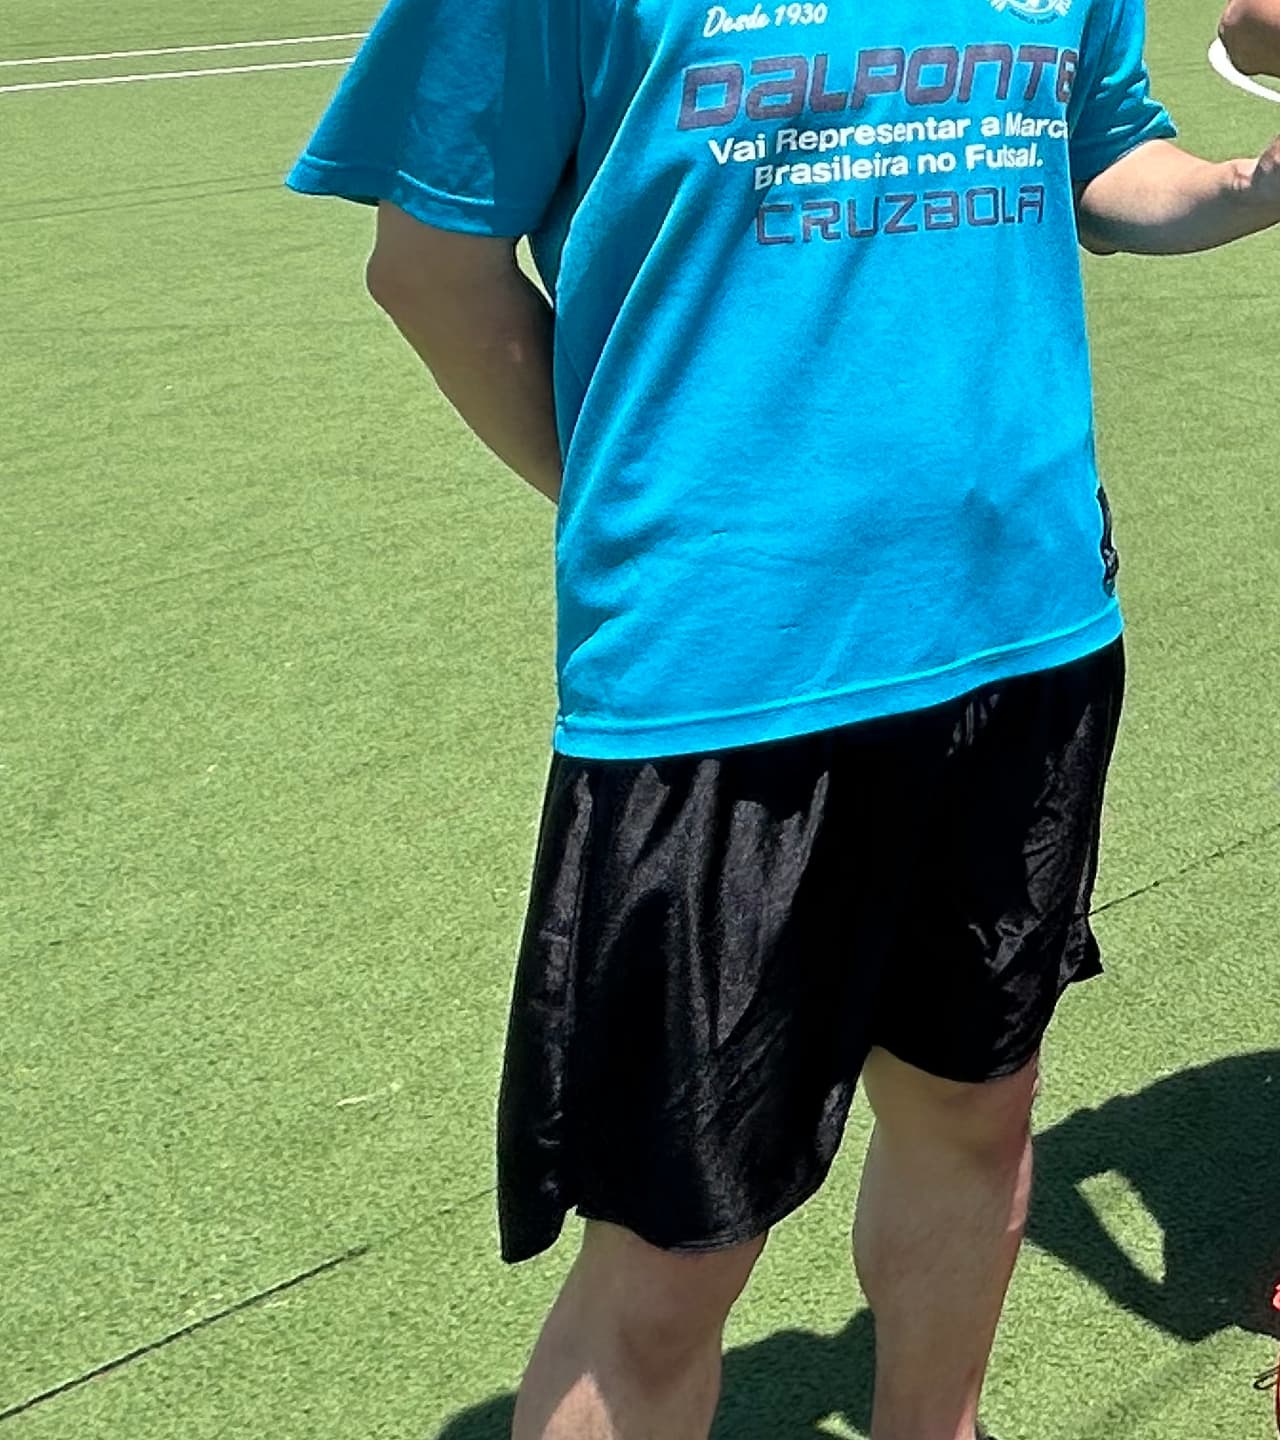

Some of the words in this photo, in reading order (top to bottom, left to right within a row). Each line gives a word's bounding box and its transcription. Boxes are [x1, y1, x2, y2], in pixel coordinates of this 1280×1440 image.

[702, 5, 770, 38] Desde
[773, 2, 828, 27] 1930
[709, 133, 767, 166] Vai
[775, 116, 972, 154] Representar
[980, 117, 1000, 137] a
[1004, 112, 1068, 139] Marc
[753, 149, 909, 191] Brasileira
[917, 151, 956, 174] no
